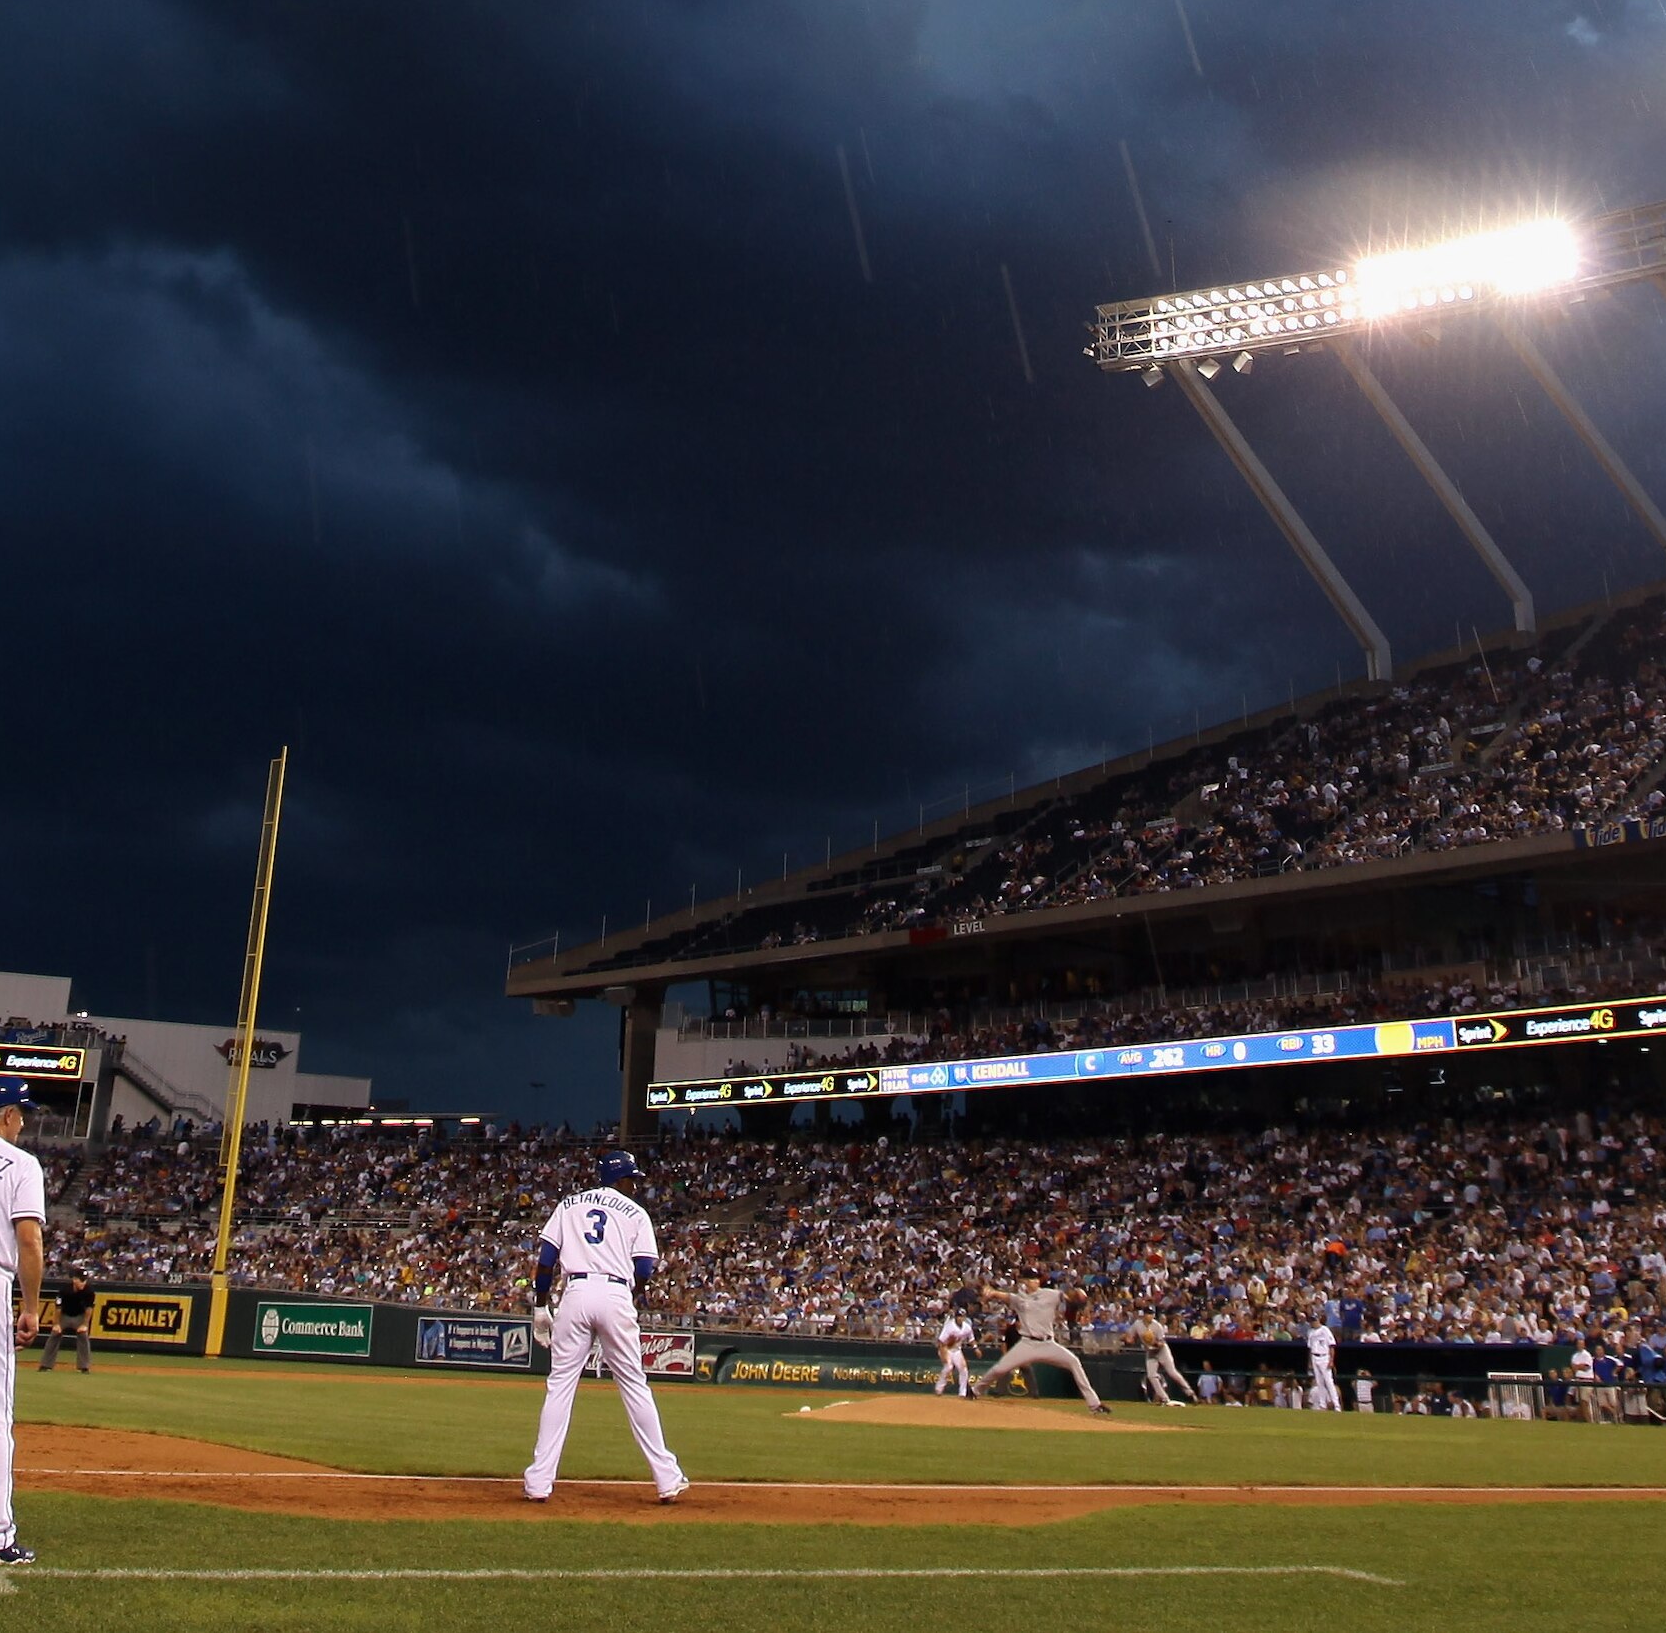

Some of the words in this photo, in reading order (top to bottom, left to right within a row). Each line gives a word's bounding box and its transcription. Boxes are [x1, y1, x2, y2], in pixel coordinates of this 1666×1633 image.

[1590, 826, 1621, 846] Tide
[953, 921, 985, 936] LEVEL
[1280, 1038, 1303, 1052] RBI
[1311, 1034, 1334, 1055] 33
[1416, 1036, 1445, 1049] MPH
[1459, 1025, 1492, 1044] Sprint
[228, 1047, 278, 1064] RIALS
[1119, 1051, 1145, 1066] AVG
[1149, 1048, 1184, 1068] .262
[1205, 1044, 1223, 1058] HR
[972, 1062, 1030, 1080] KENDALL
[1086, 1055, 1096, 1071] C
[744, 1084, 764, 1099] Sprint
[847, 1077, 868, 1092] Sprint
[563, 1192, 640, 1219] BETANCOURT
[584, 1208, 608, 1245] 3
[167, 1273, 183, 1284] 330
[106, 1307, 179, 1328] STANLEY
[281, 1317, 338, 1337] Commerce
[338, 1319, 365, 1338] Bank
[731, 1360, 769, 1381] JOHN
[770, 1360, 820, 1382] DEERE
[832, 1367, 879, 1385] Nothing
[881, 1367, 911, 1383] Runs
